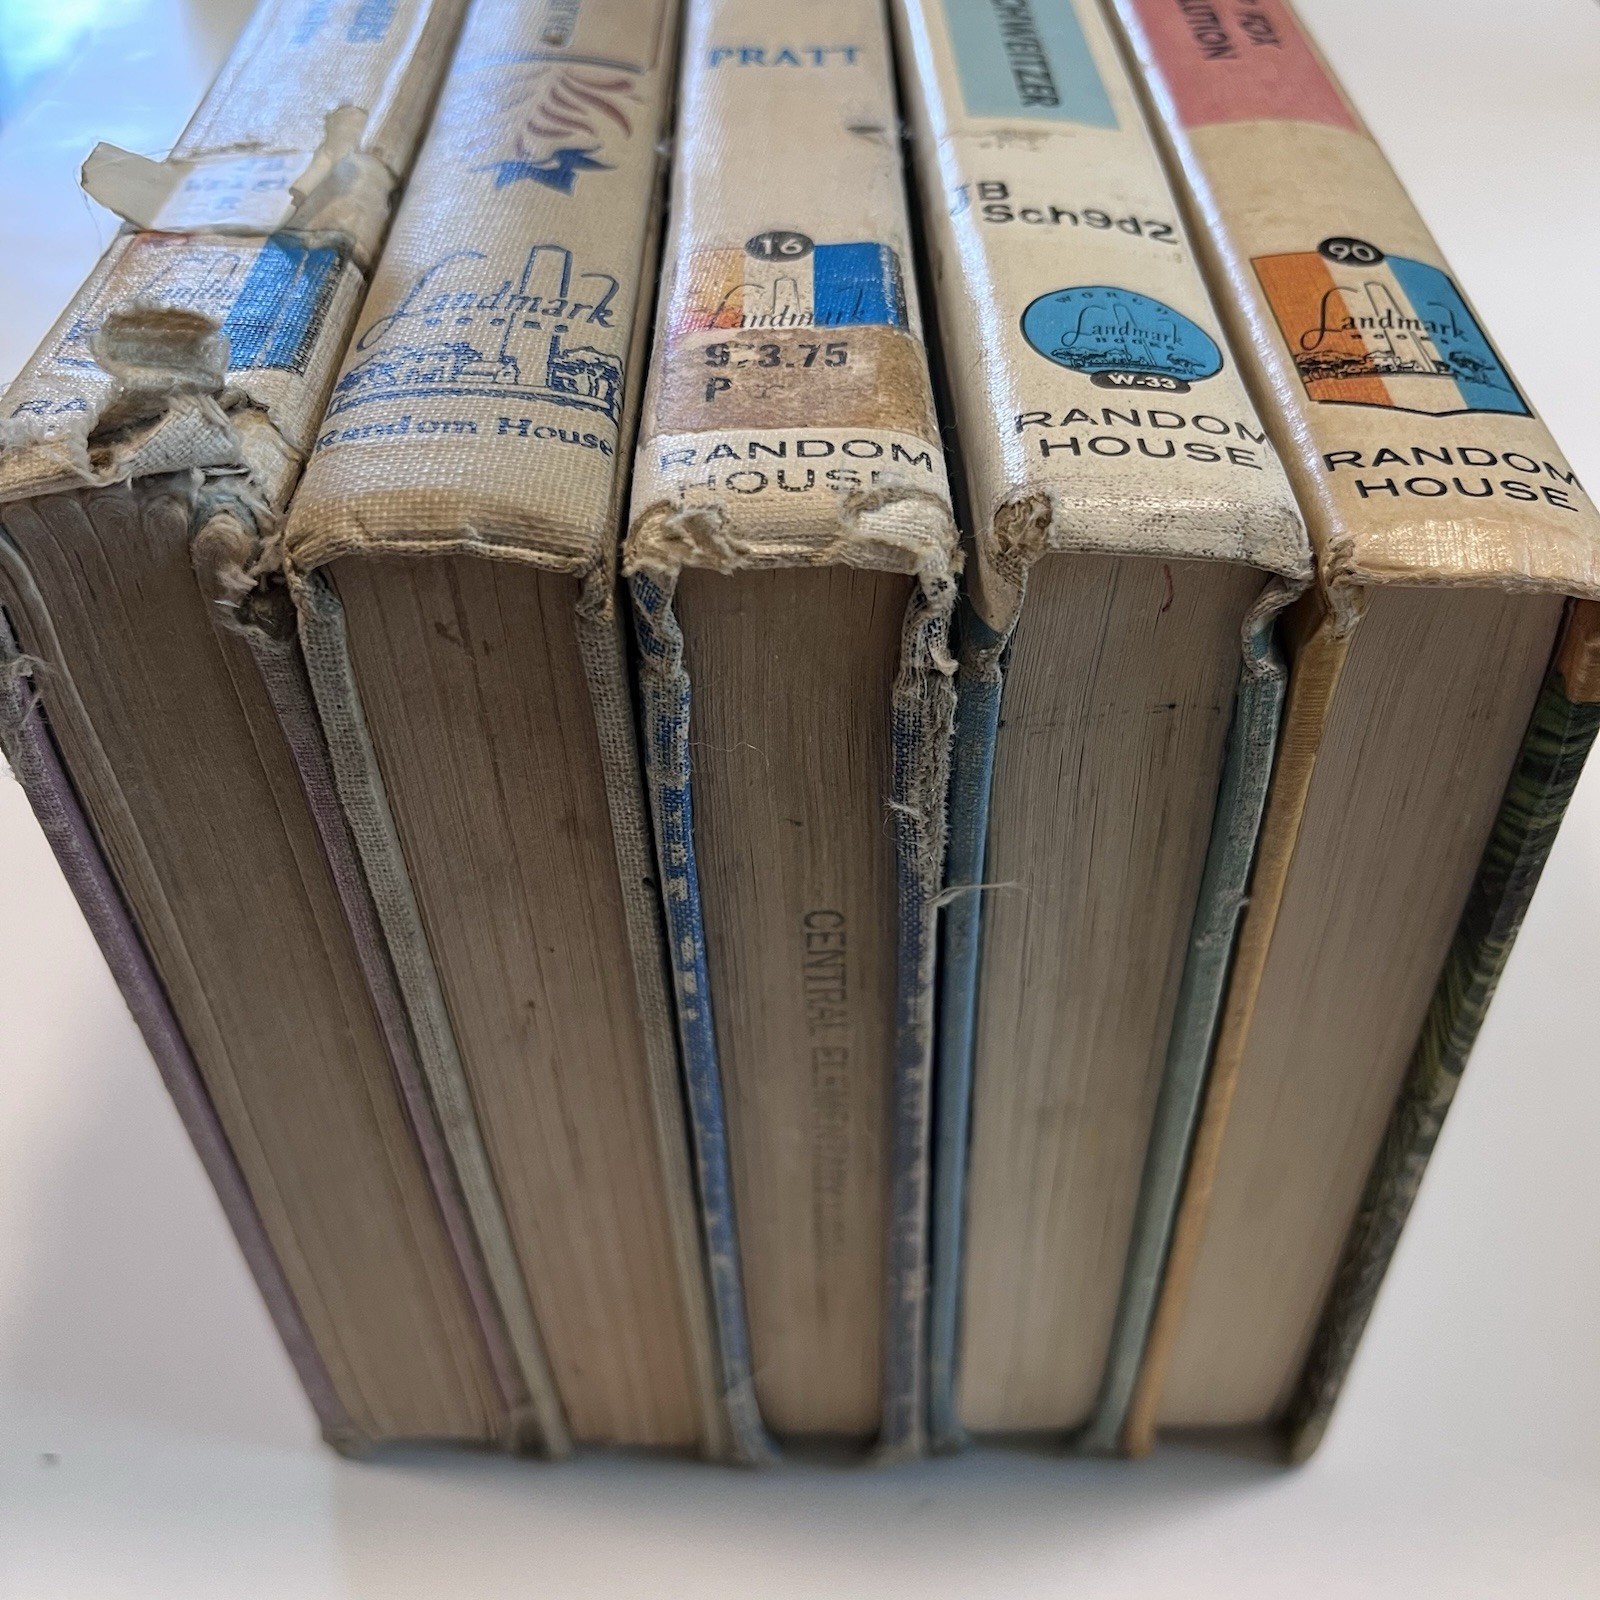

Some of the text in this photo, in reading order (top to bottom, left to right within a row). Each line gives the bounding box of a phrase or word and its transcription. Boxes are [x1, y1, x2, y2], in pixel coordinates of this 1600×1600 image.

[1178, 0, 1238, 60] UTION
[708, 44, 864, 69] PRATT
[761, 238, 804, 255] 16
[1328, 242, 1376, 262] 90
[356, 250, 620, 351] Landmark
[1300, 286, 1469, 350] Landmark
[1060, 304, 1185, 347] Landmark
[704, 376, 732, 402] P
[1107, 373, 1178, 391] W-33
[315, 414, 615, 457] Random House
[1013, 408, 1267, 445] RANDOM
[659, 439, 933, 473] RANDOM
[1038, 436, 1263, 471] HOUSE
[1322, 446, 1585, 492] RANDOM
[1355, 476, 1580, 513] HOUSE
[803, 909, 848, 1037] CENTRAL
